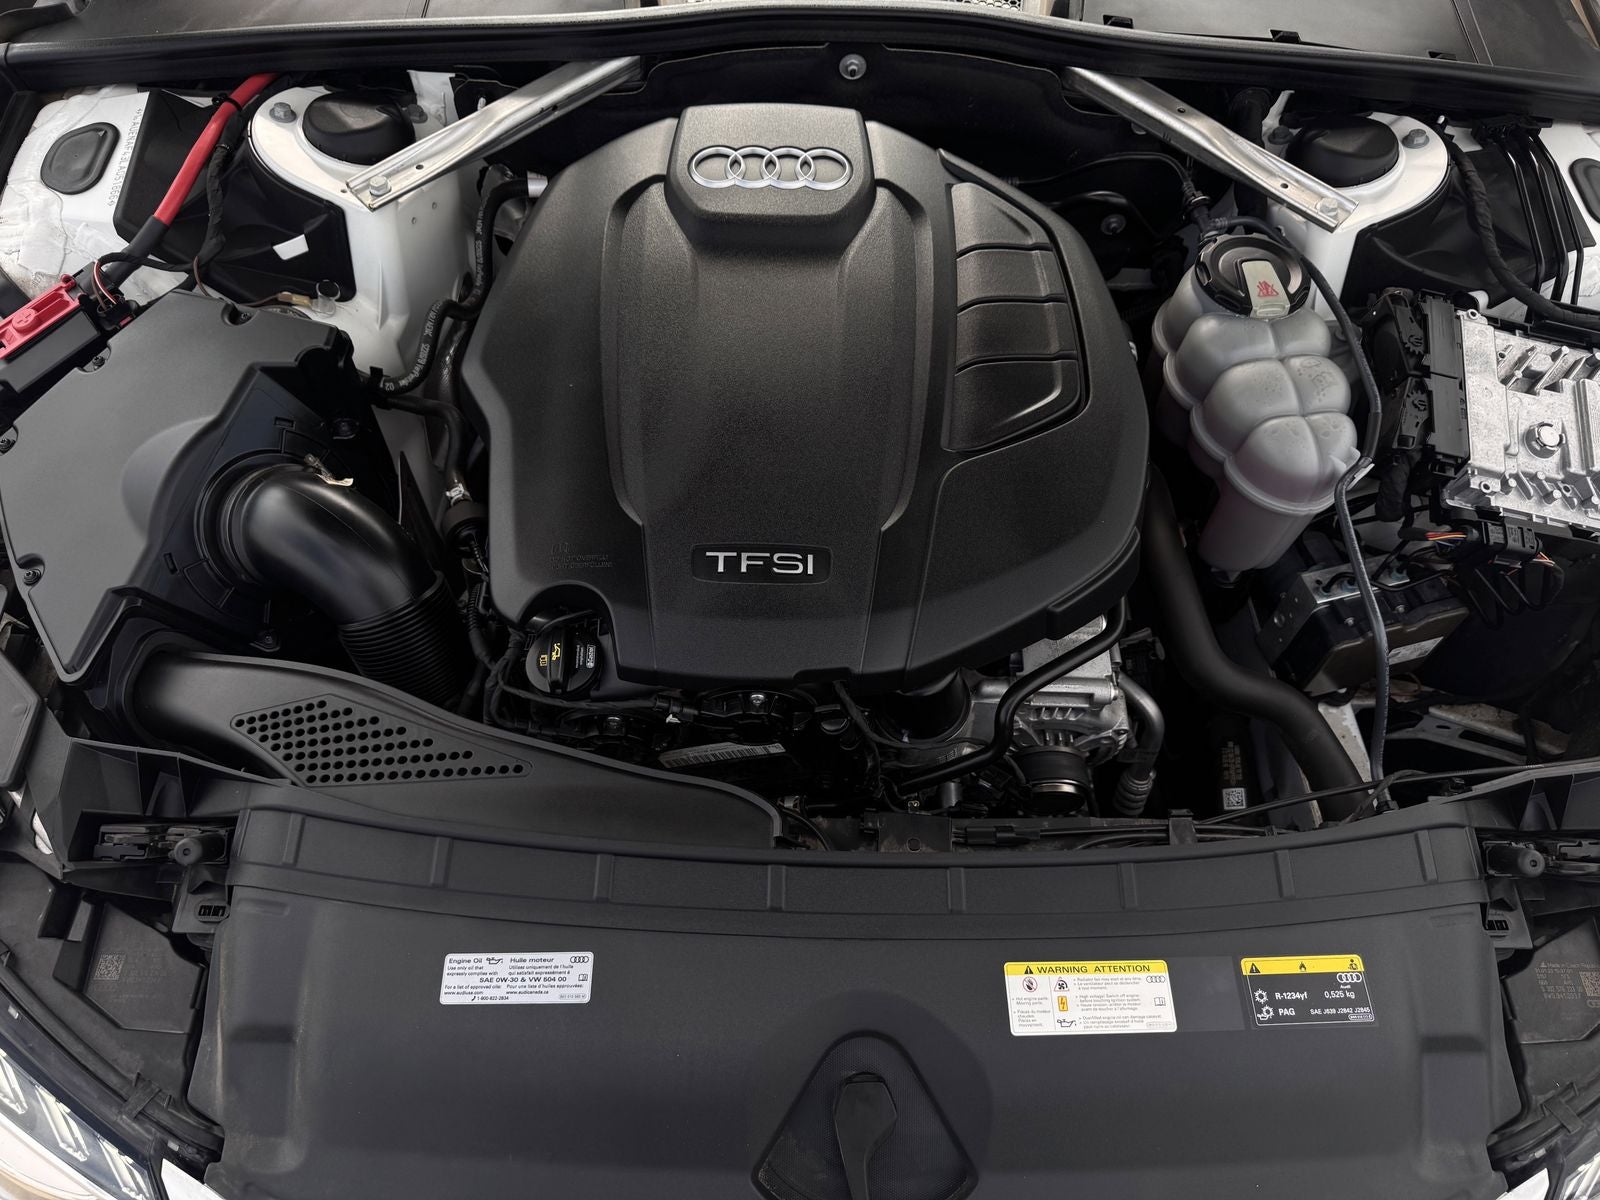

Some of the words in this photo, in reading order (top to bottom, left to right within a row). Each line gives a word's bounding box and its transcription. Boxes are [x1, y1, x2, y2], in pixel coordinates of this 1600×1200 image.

[706, 552, 814, 574] TFSI
[1037, 966, 1088, 974] WARNING
[1275, 992, 1308, 1000] R-1234yf
[1324, 990, 1345, 999] 0,525
[1345, 990, 1355, 999] kg
